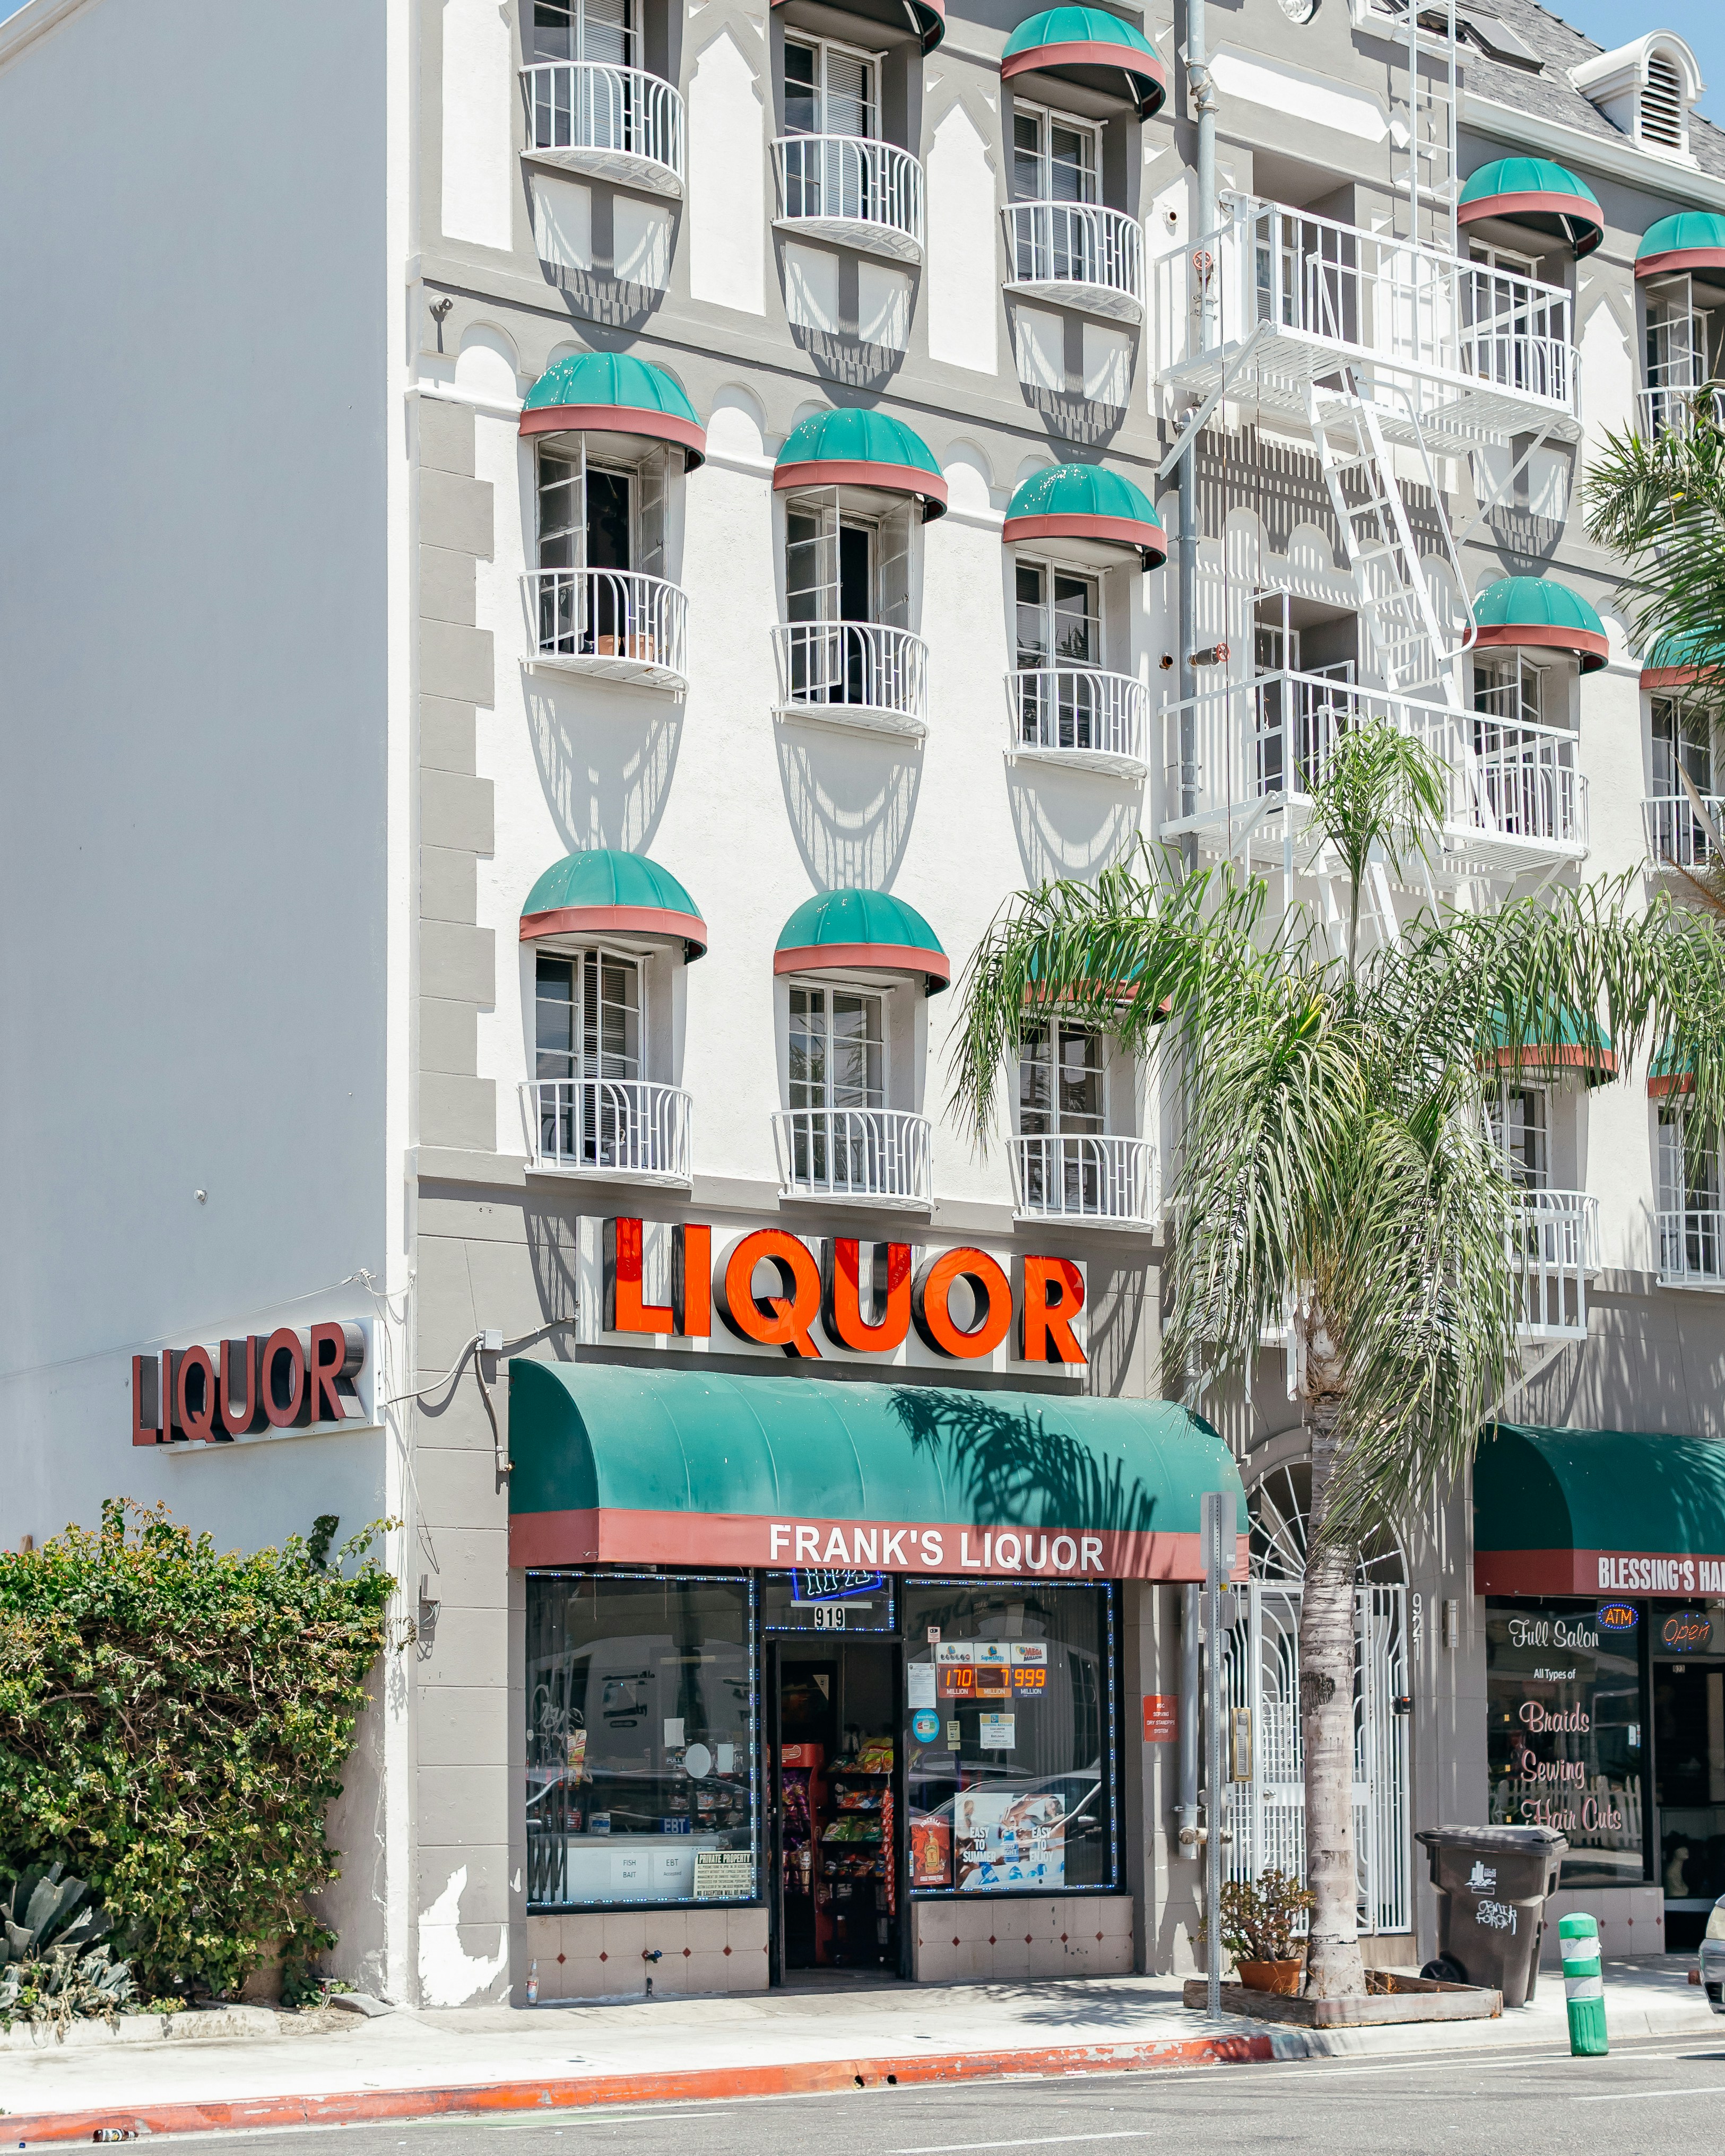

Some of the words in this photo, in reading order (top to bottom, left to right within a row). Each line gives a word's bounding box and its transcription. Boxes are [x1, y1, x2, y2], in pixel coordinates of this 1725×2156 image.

[616, 1216, 1088, 1364] LIQUOR
[132, 1322, 348, 1446] LIQUOR
[769, 1523, 944, 1567] FRANK'S
[960, 1532, 1105, 1571] LIQUOR
[1598, 1557, 1695, 1592] BLESSING'S
[816, 1607, 844, 1627] 919
[1605, 1609, 1632, 1625] ATM
[1412, 1593, 1423, 1661] 921
[1509, 1619, 1549, 1647] Full
[1553, 1620, 1599, 1648] Salon
[1663, 1619, 1710, 1645] Open
[946, 1668, 972, 1687] 170
[1001, 1668, 1009, 1686] 7
[1014, 1668, 1046, 1687] 999
[1533, 1668, 1544, 1679] All
[1545, 1668, 1566, 1681] Types
[1567, 1668, 1576, 1679] of
[1519, 1700, 1589, 1733] Braids
[1520, 1750, 1585, 1789] Sewing
[1521, 1798, 1576, 1831] Hair
[1582, 1796, 1622, 1832] Cuts
[664, 1818, 686, 1834] EBT
[970, 1827, 990, 1838] EASY
[1031, 1827, 1052, 1838] EASY
[974, 1838, 985, 1850] TO
[1037, 1838, 1047, 1850] TO
[699, 1854, 722, 1864] PRIVATE
[723, 1853, 751, 1863] PROPERTY
[963, 1850, 996, 1863] SUMMER
[1029, 1850, 1054, 1863] ENJOY
